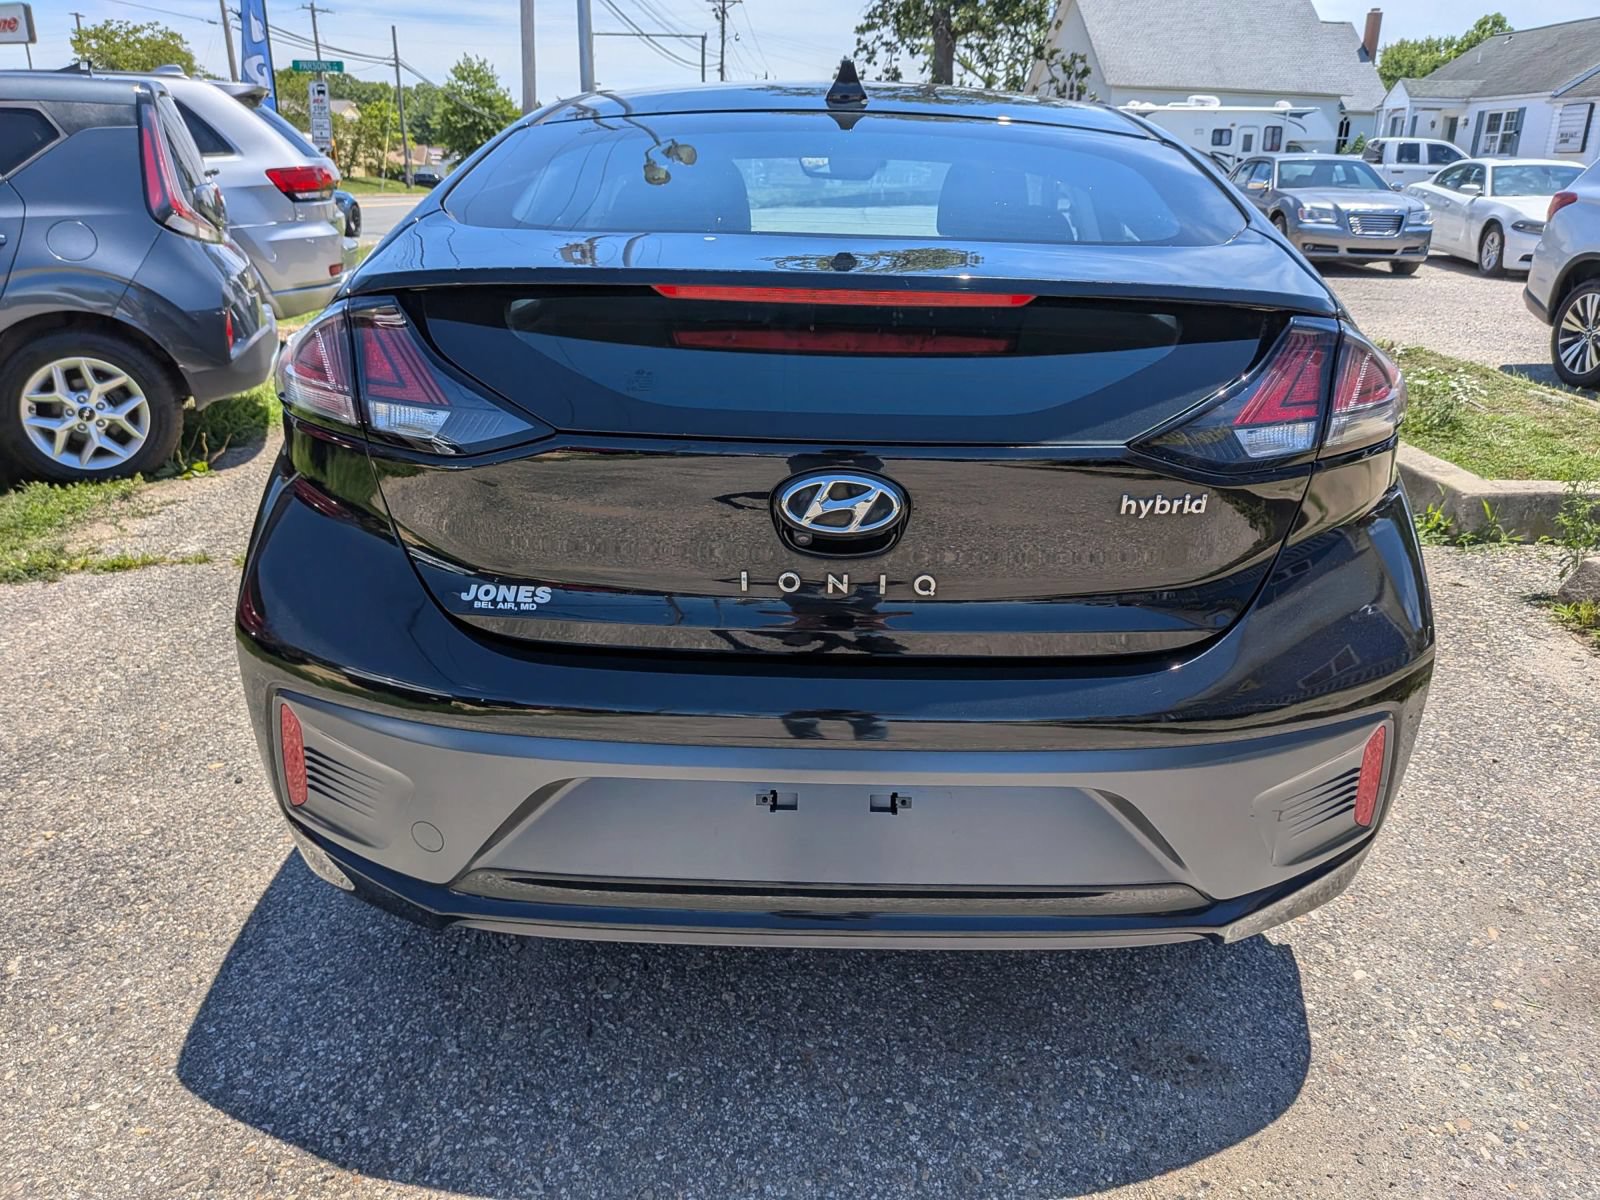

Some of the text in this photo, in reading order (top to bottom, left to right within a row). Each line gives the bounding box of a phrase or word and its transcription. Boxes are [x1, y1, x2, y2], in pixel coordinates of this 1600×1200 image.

[299, 61, 331, 71] PARSONS
[1120, 494, 1208, 519] hybrid
[740, 571, 936, 596] IONIQ
[460, 584, 552, 603] JONES
[473, 601, 537, 611] BEL AIR, MD
